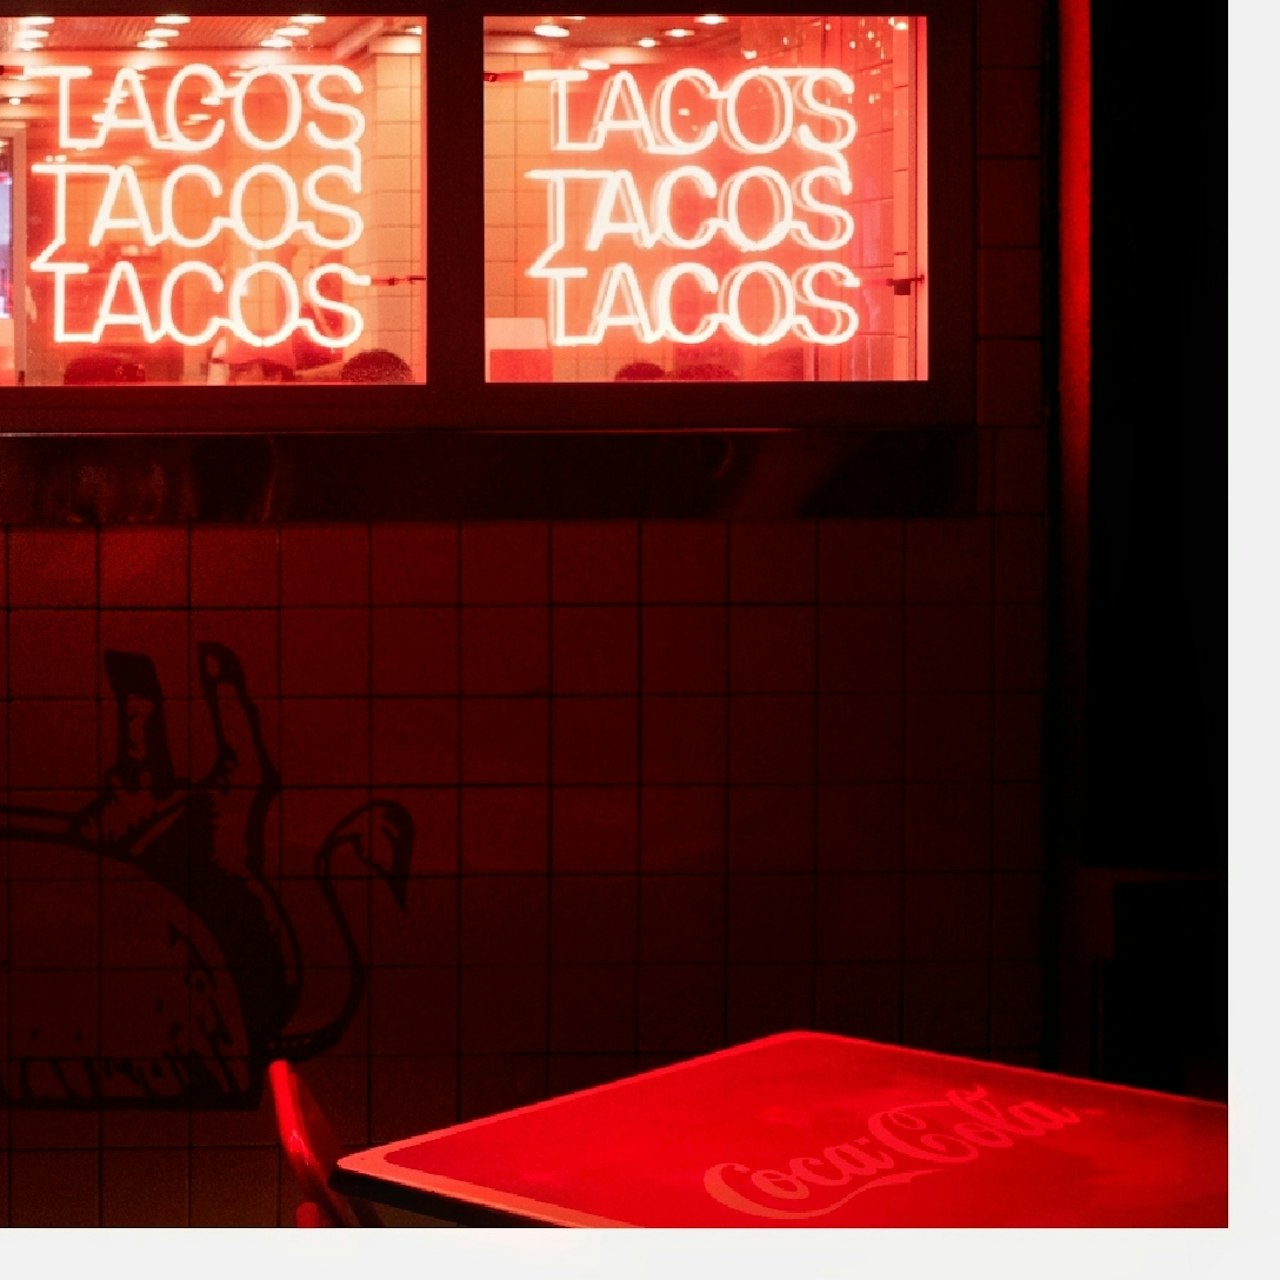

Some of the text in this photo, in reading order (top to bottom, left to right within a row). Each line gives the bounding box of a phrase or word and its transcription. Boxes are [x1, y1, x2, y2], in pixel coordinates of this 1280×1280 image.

[24, 63, 366, 152] TACOS
[524, 67, 857, 154] TACOS
[32, 163, 363, 250] TACOS
[525, 165, 854, 252] TACOS
[30, 261, 371, 348] TACOS
[525, 262, 860, 346] TACOS
[703, 1085, 1085, 1219] Coca-Cola
